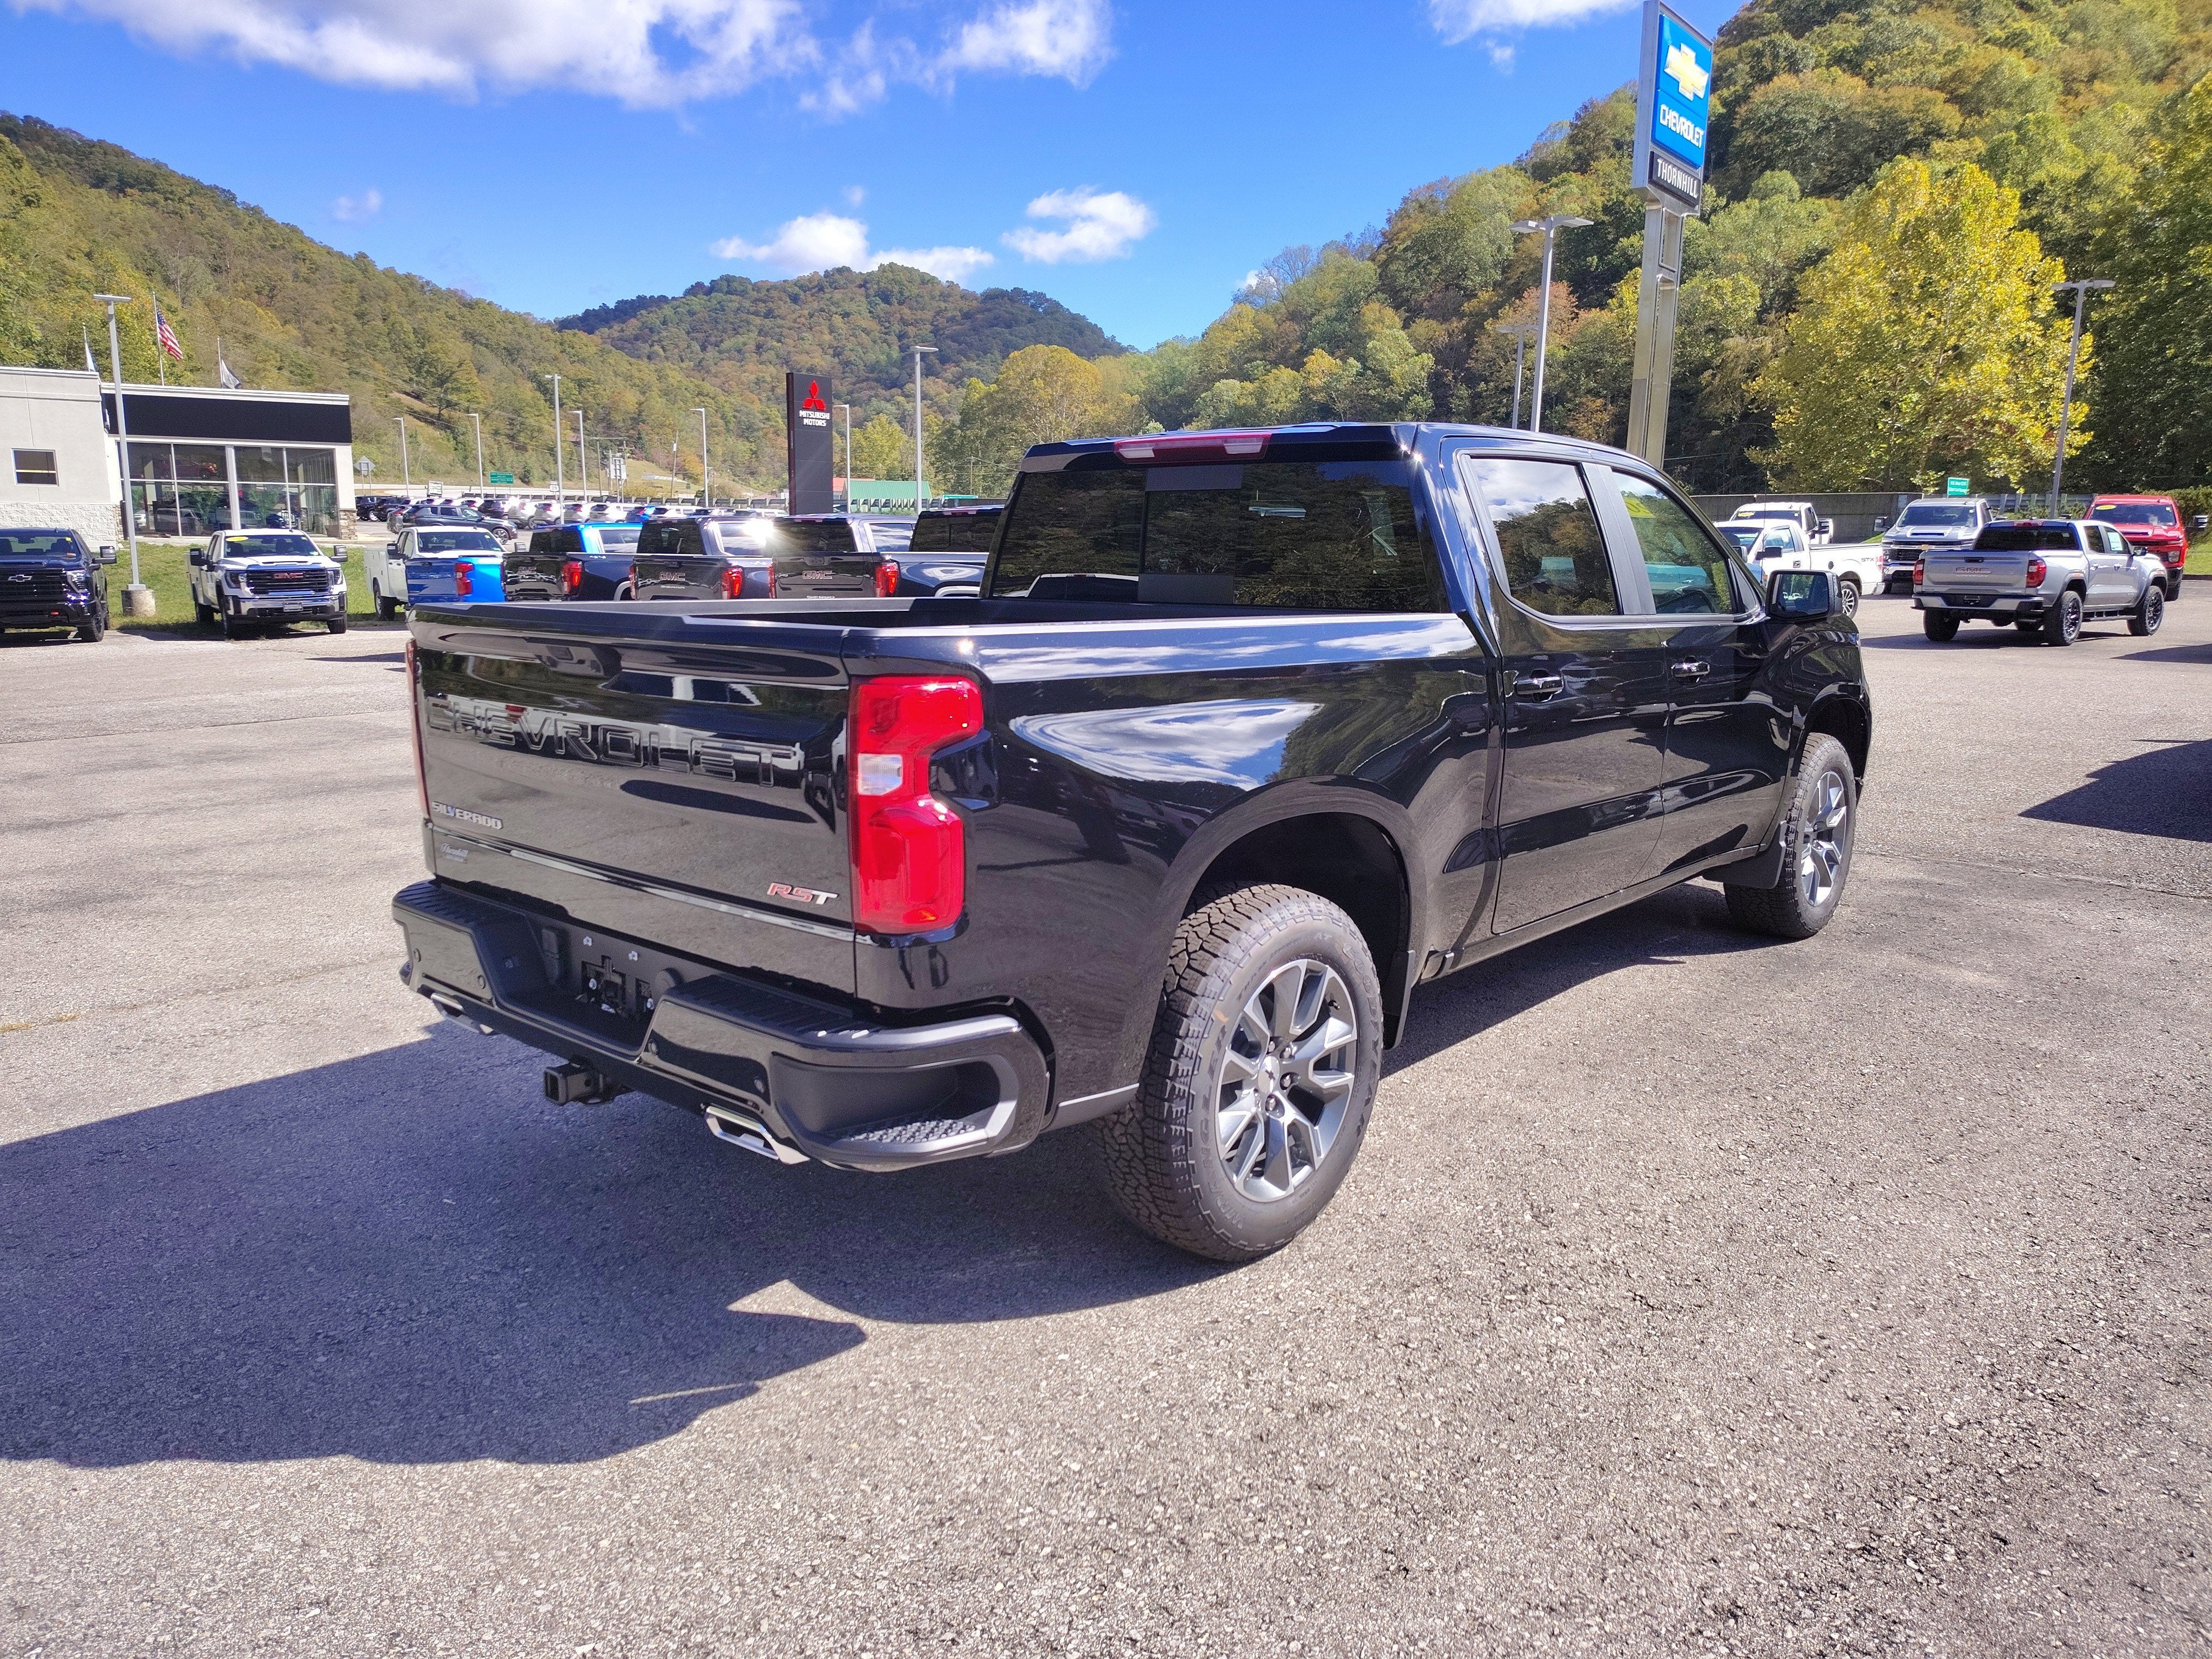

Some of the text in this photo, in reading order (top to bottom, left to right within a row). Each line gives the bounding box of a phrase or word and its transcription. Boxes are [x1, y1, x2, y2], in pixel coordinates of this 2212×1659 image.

[1660, 103, 1704, 149] CHEVROLET
[1657, 159, 1698, 199] THORNHILL
[799, 410, 830, 420] MITSUBISHI
[803, 418, 826, 427] MOTORS
[659, 572, 686, 581] GMC
[802, 570, 833, 579] GMC
[426, 698, 797, 787] CHEVROLET
[431, 801, 504, 830] SILVERADO
[767, 882, 839, 905] RST
